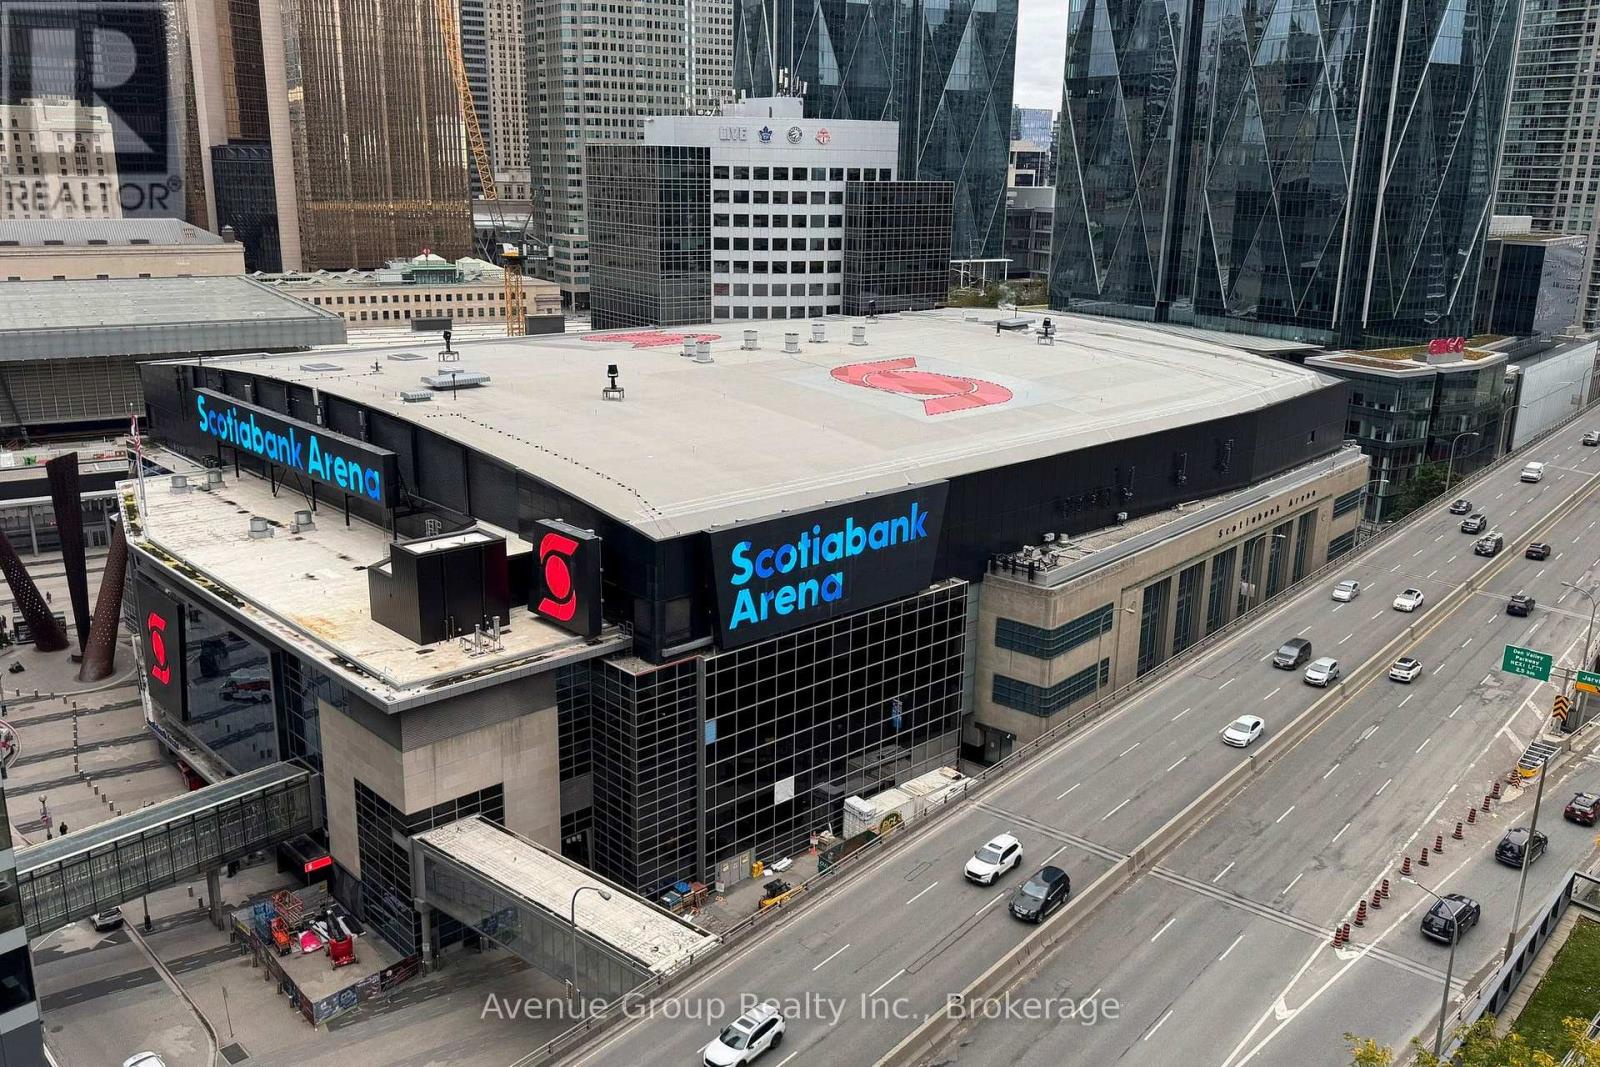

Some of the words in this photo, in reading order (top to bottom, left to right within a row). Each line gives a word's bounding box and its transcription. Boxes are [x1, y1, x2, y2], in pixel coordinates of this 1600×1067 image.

[719, 127, 747, 141] LIVE
[197, 395, 304, 470] Scotiabank
[308, 435, 381, 501] Arena
[1218, 505, 1280, 538] Scotiabank
[1288, 490, 1316, 508] Arena
[730, 502, 928, 585] Scotiabank
[729, 571, 843, 630] Arena
[1515, 655, 1540, 665] Parkway
[1526, 651, 1544, 661] Valley
